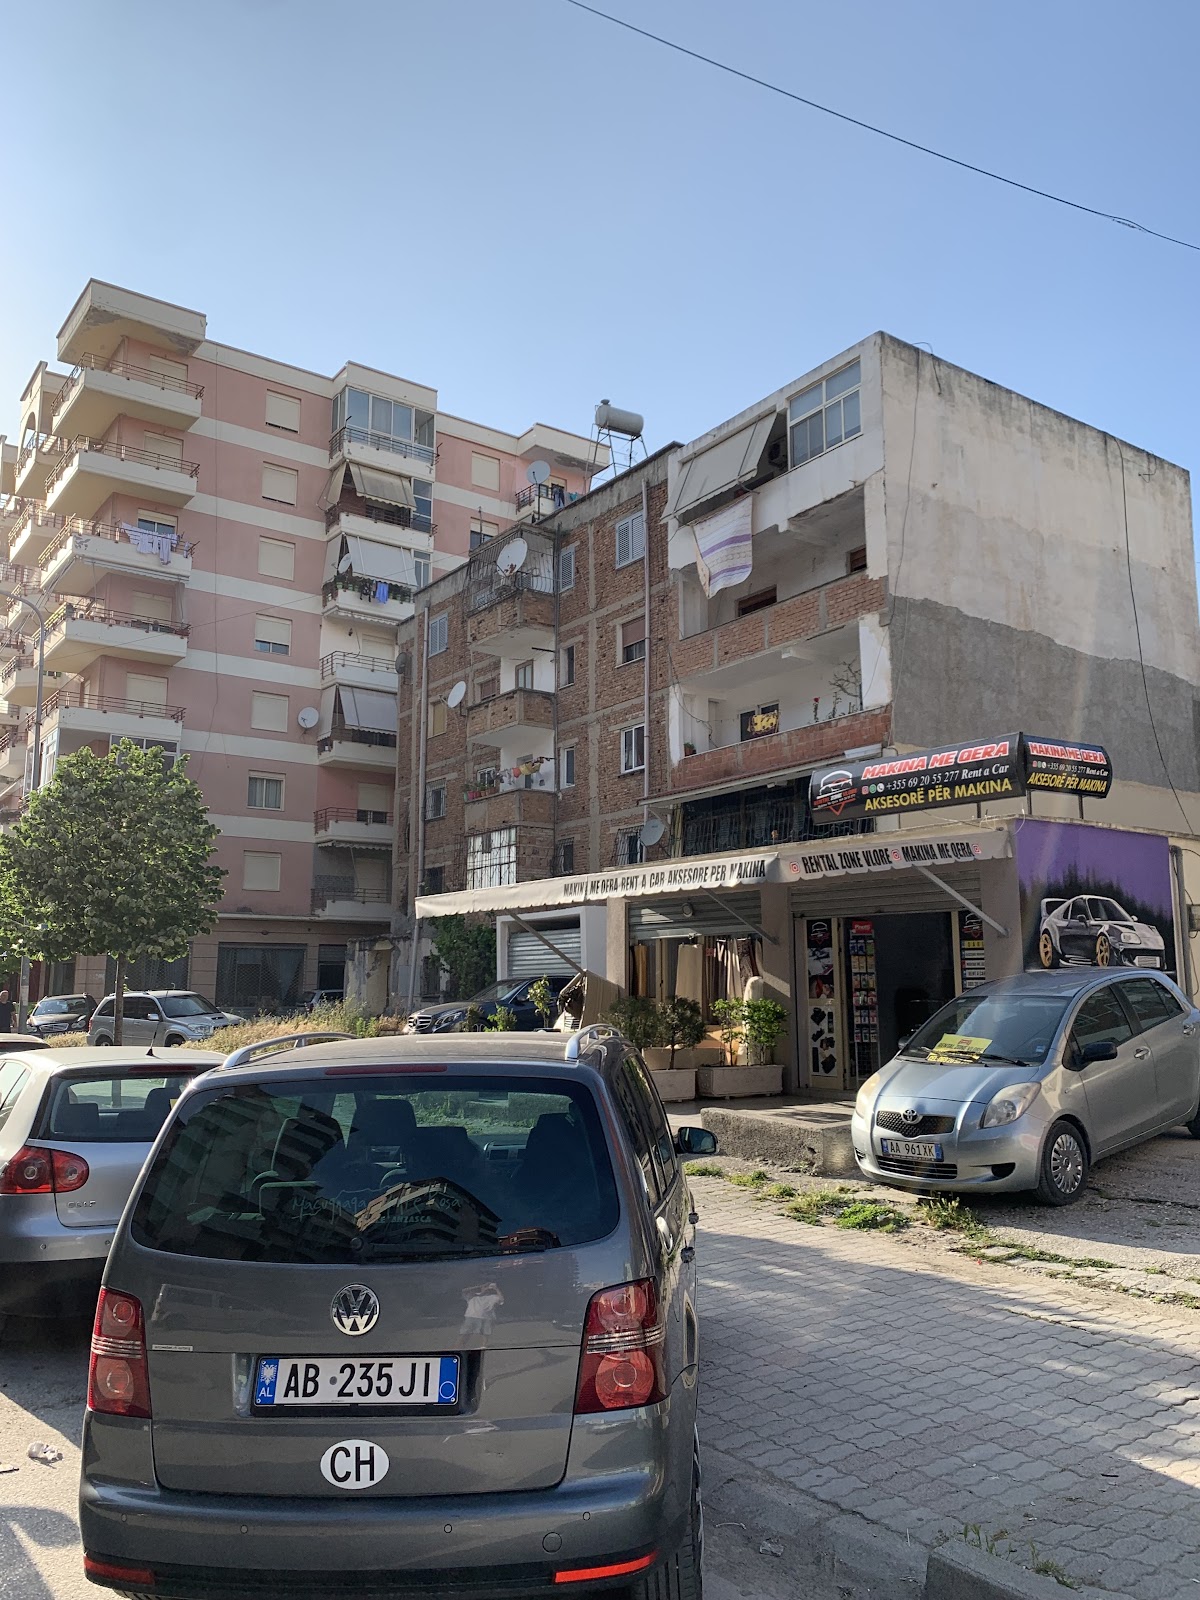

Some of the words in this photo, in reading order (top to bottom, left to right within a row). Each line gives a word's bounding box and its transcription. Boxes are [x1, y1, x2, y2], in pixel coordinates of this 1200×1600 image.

[861, 756, 927, 780] MAKINA
[929, 750, 958, 769] ME
[957, 741, 1009, 764] QERA
[1028, 742, 1067, 759] MAKINA
[1065, 746, 1082, 761] ME
[1080, 749, 1107, 765] QERA
[886, 779, 906, 791] +355
[908, 777, 918, 788] 69
[920, 775, 930, 786] 20
[932, 773, 941, 784] 55
[944, 771, 960, 782] 277
[961, 768, 981, 779] Rent
[984, 767, 989, 776] a
[992, 763, 1009, 775] Car
[1027, 772, 1066, 788] AKSESORË
[1064, 774, 1079, 789] PËR
[1077, 778, 1107, 793] MAKINA
[864, 787, 925, 811] AKSESORË
[928, 783, 950, 802] PËR
[955, 778, 1013, 798] MAKINA
[801, 853, 840, 874] RENTAL
[838, 851, 863, 869] ZONE
[862, 848, 892, 867] VLORE
[901, 844, 938, 863] MAKINA
[937, 843, 952, 858] ME
[950, 842, 975, 859] QERA
[590, 880, 600, 894] ME
[641, 873, 646, 889] A
[710, 864, 727, 881] PER
[729, 860, 766, 880] MAKINA
[890, 1141, 901, 1153] AA
[259, 1387, 273, 1397] AL
[283, 1363, 320, 1398] AB
[337, 1362, 394, 1398] 235
[399, 1362, 431, 1397] JI
[330, 1446, 375, 1483] CH
